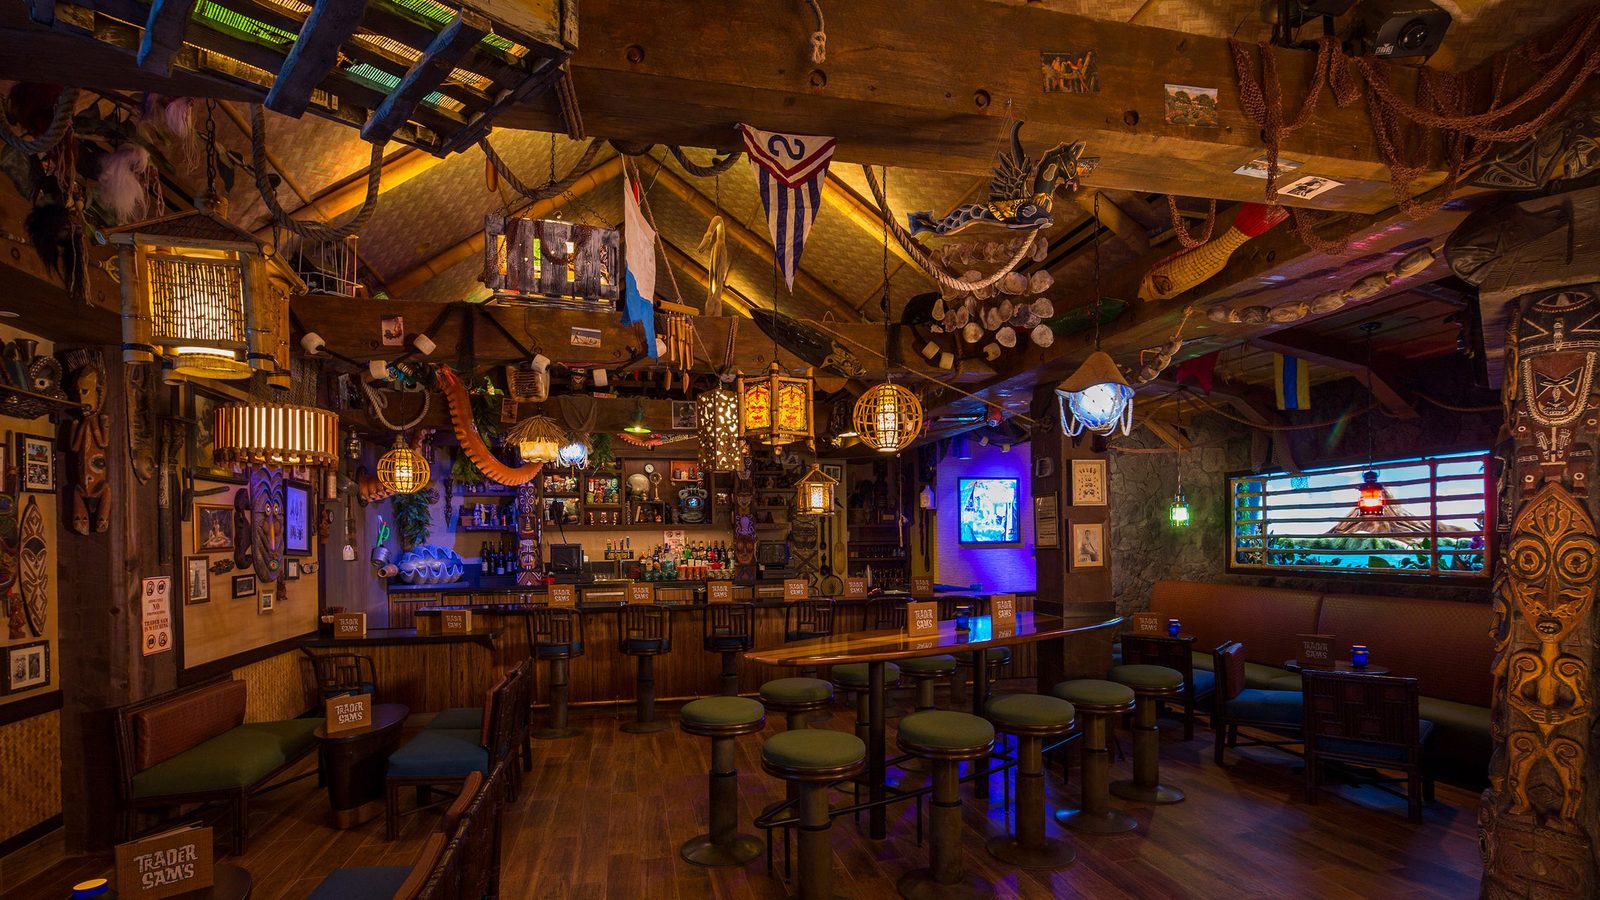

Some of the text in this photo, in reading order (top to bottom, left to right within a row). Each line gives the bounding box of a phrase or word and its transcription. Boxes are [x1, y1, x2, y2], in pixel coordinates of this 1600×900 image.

[914, 609, 933, 620] TRADER
[334, 701, 364, 715] TRADER
[133, 844, 198, 873] TRADER
[141, 863, 195, 890] SAM'S
